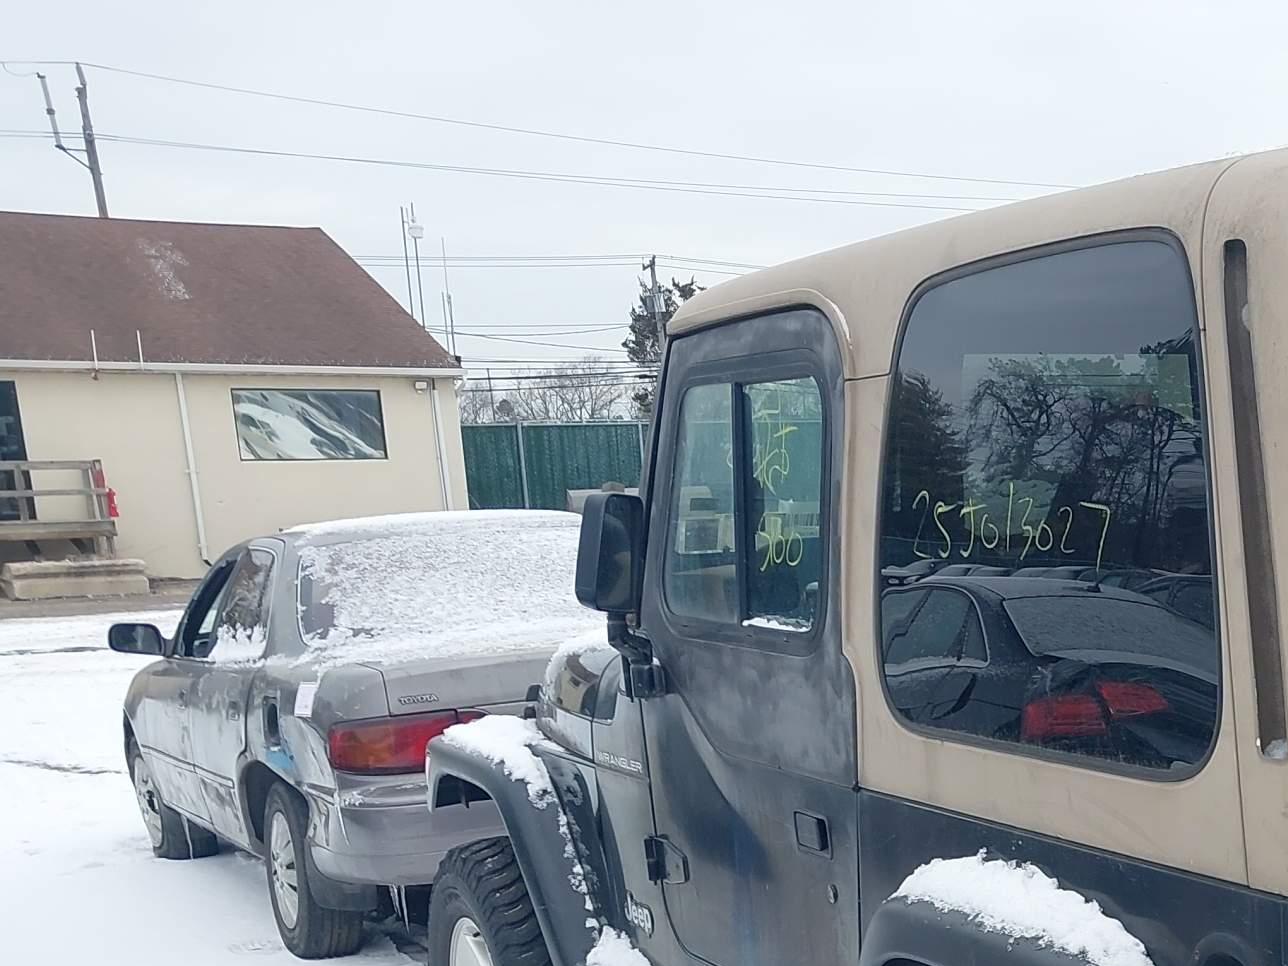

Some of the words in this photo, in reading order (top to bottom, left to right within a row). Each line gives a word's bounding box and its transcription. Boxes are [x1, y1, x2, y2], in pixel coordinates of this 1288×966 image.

[912, 481, 1111, 575] 25J013027
[400, 693, 440, 706] TOYOTA
[596, 750, 643, 773] WRANGLER
[624, 890, 652, 933] Jeep
